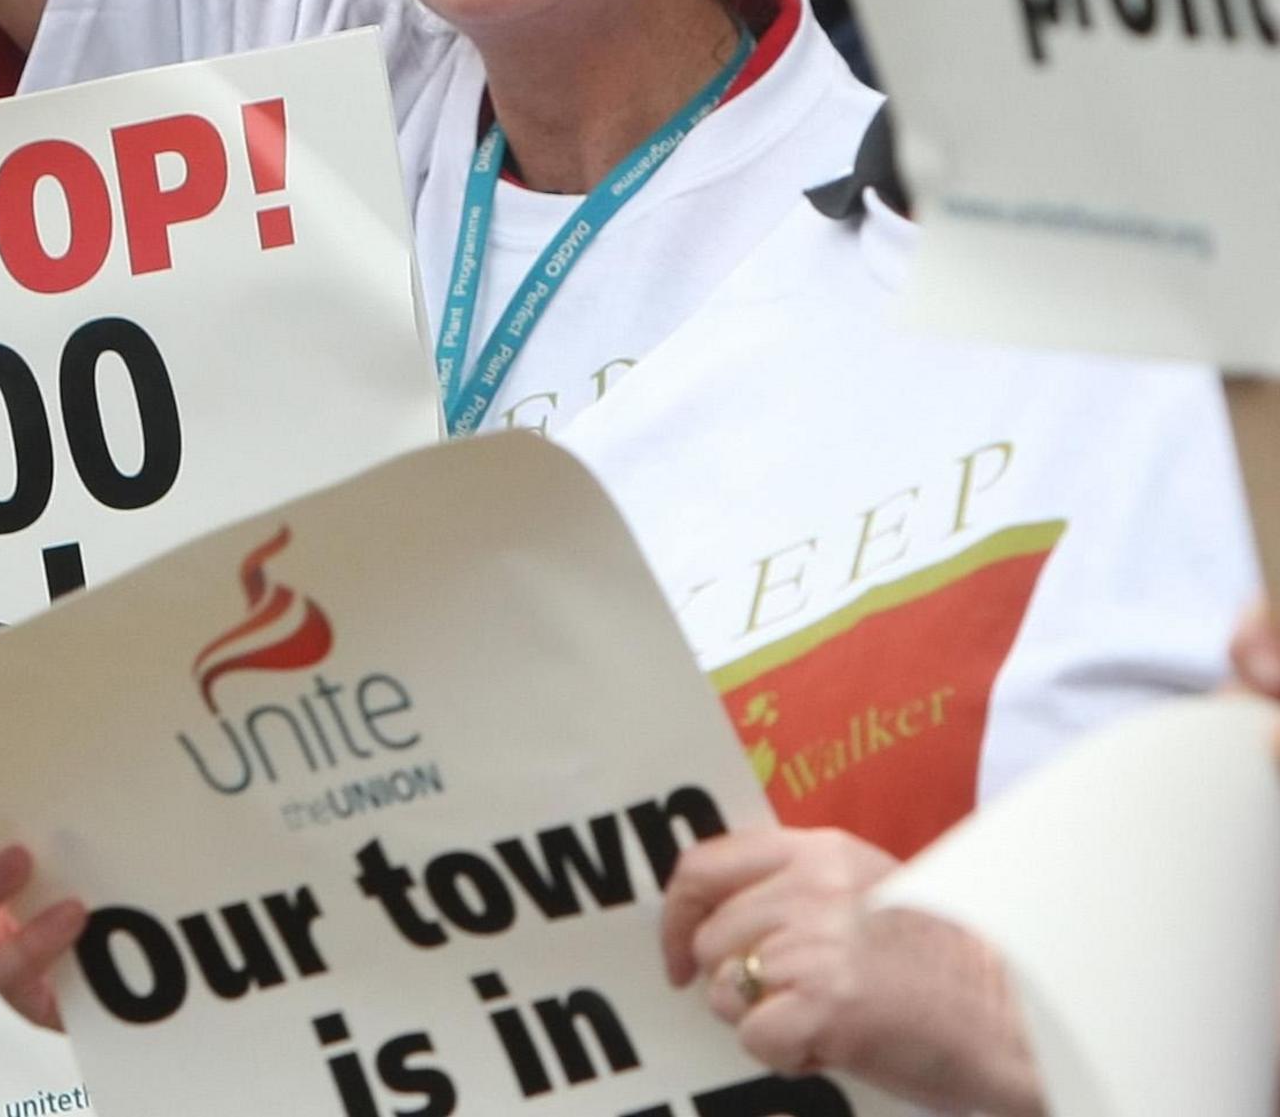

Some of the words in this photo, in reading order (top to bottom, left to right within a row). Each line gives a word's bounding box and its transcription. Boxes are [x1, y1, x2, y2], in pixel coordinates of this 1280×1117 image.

[544, 219, 592, 277] DIAGEO
[705, 441, 1015, 639] EEP
[176, 670, 423, 796] unite
[780, 686, 956, 802] Walker
[68, 884, 329, 1027] Our
[354, 785, 728, 950] town
[310, 1011, 458, 1117] is
[469, 970, 641, 1099] in
